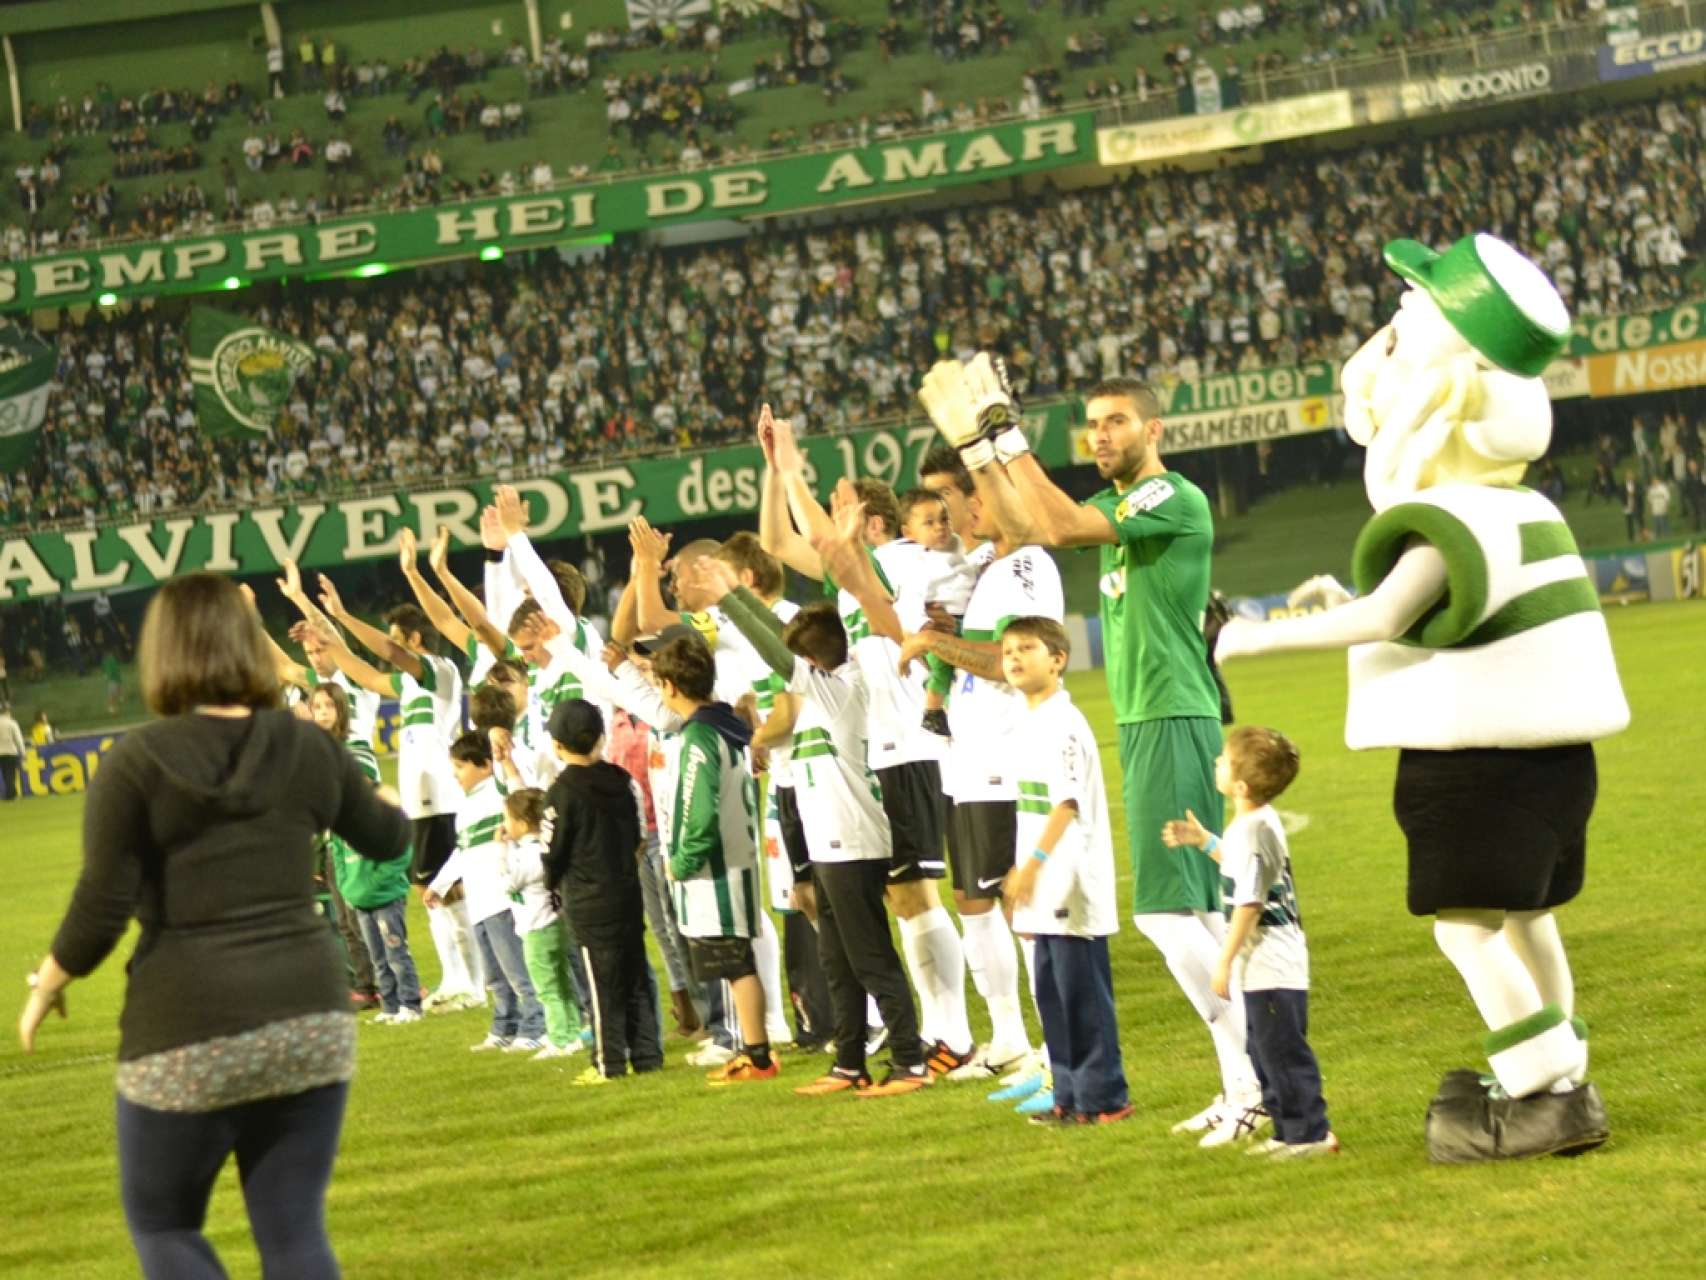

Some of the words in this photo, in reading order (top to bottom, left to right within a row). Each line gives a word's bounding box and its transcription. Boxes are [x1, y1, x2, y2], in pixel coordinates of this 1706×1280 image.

[436, 192, 596, 245] HEI
[645, 170, 768, 218] DE
[816, 121, 1078, 192] AMAR
[1162, 406, 1290, 450] NSAMÉRICA
[0, 469, 644, 598] ALVIVERDE
[677, 452, 819, 516] des
